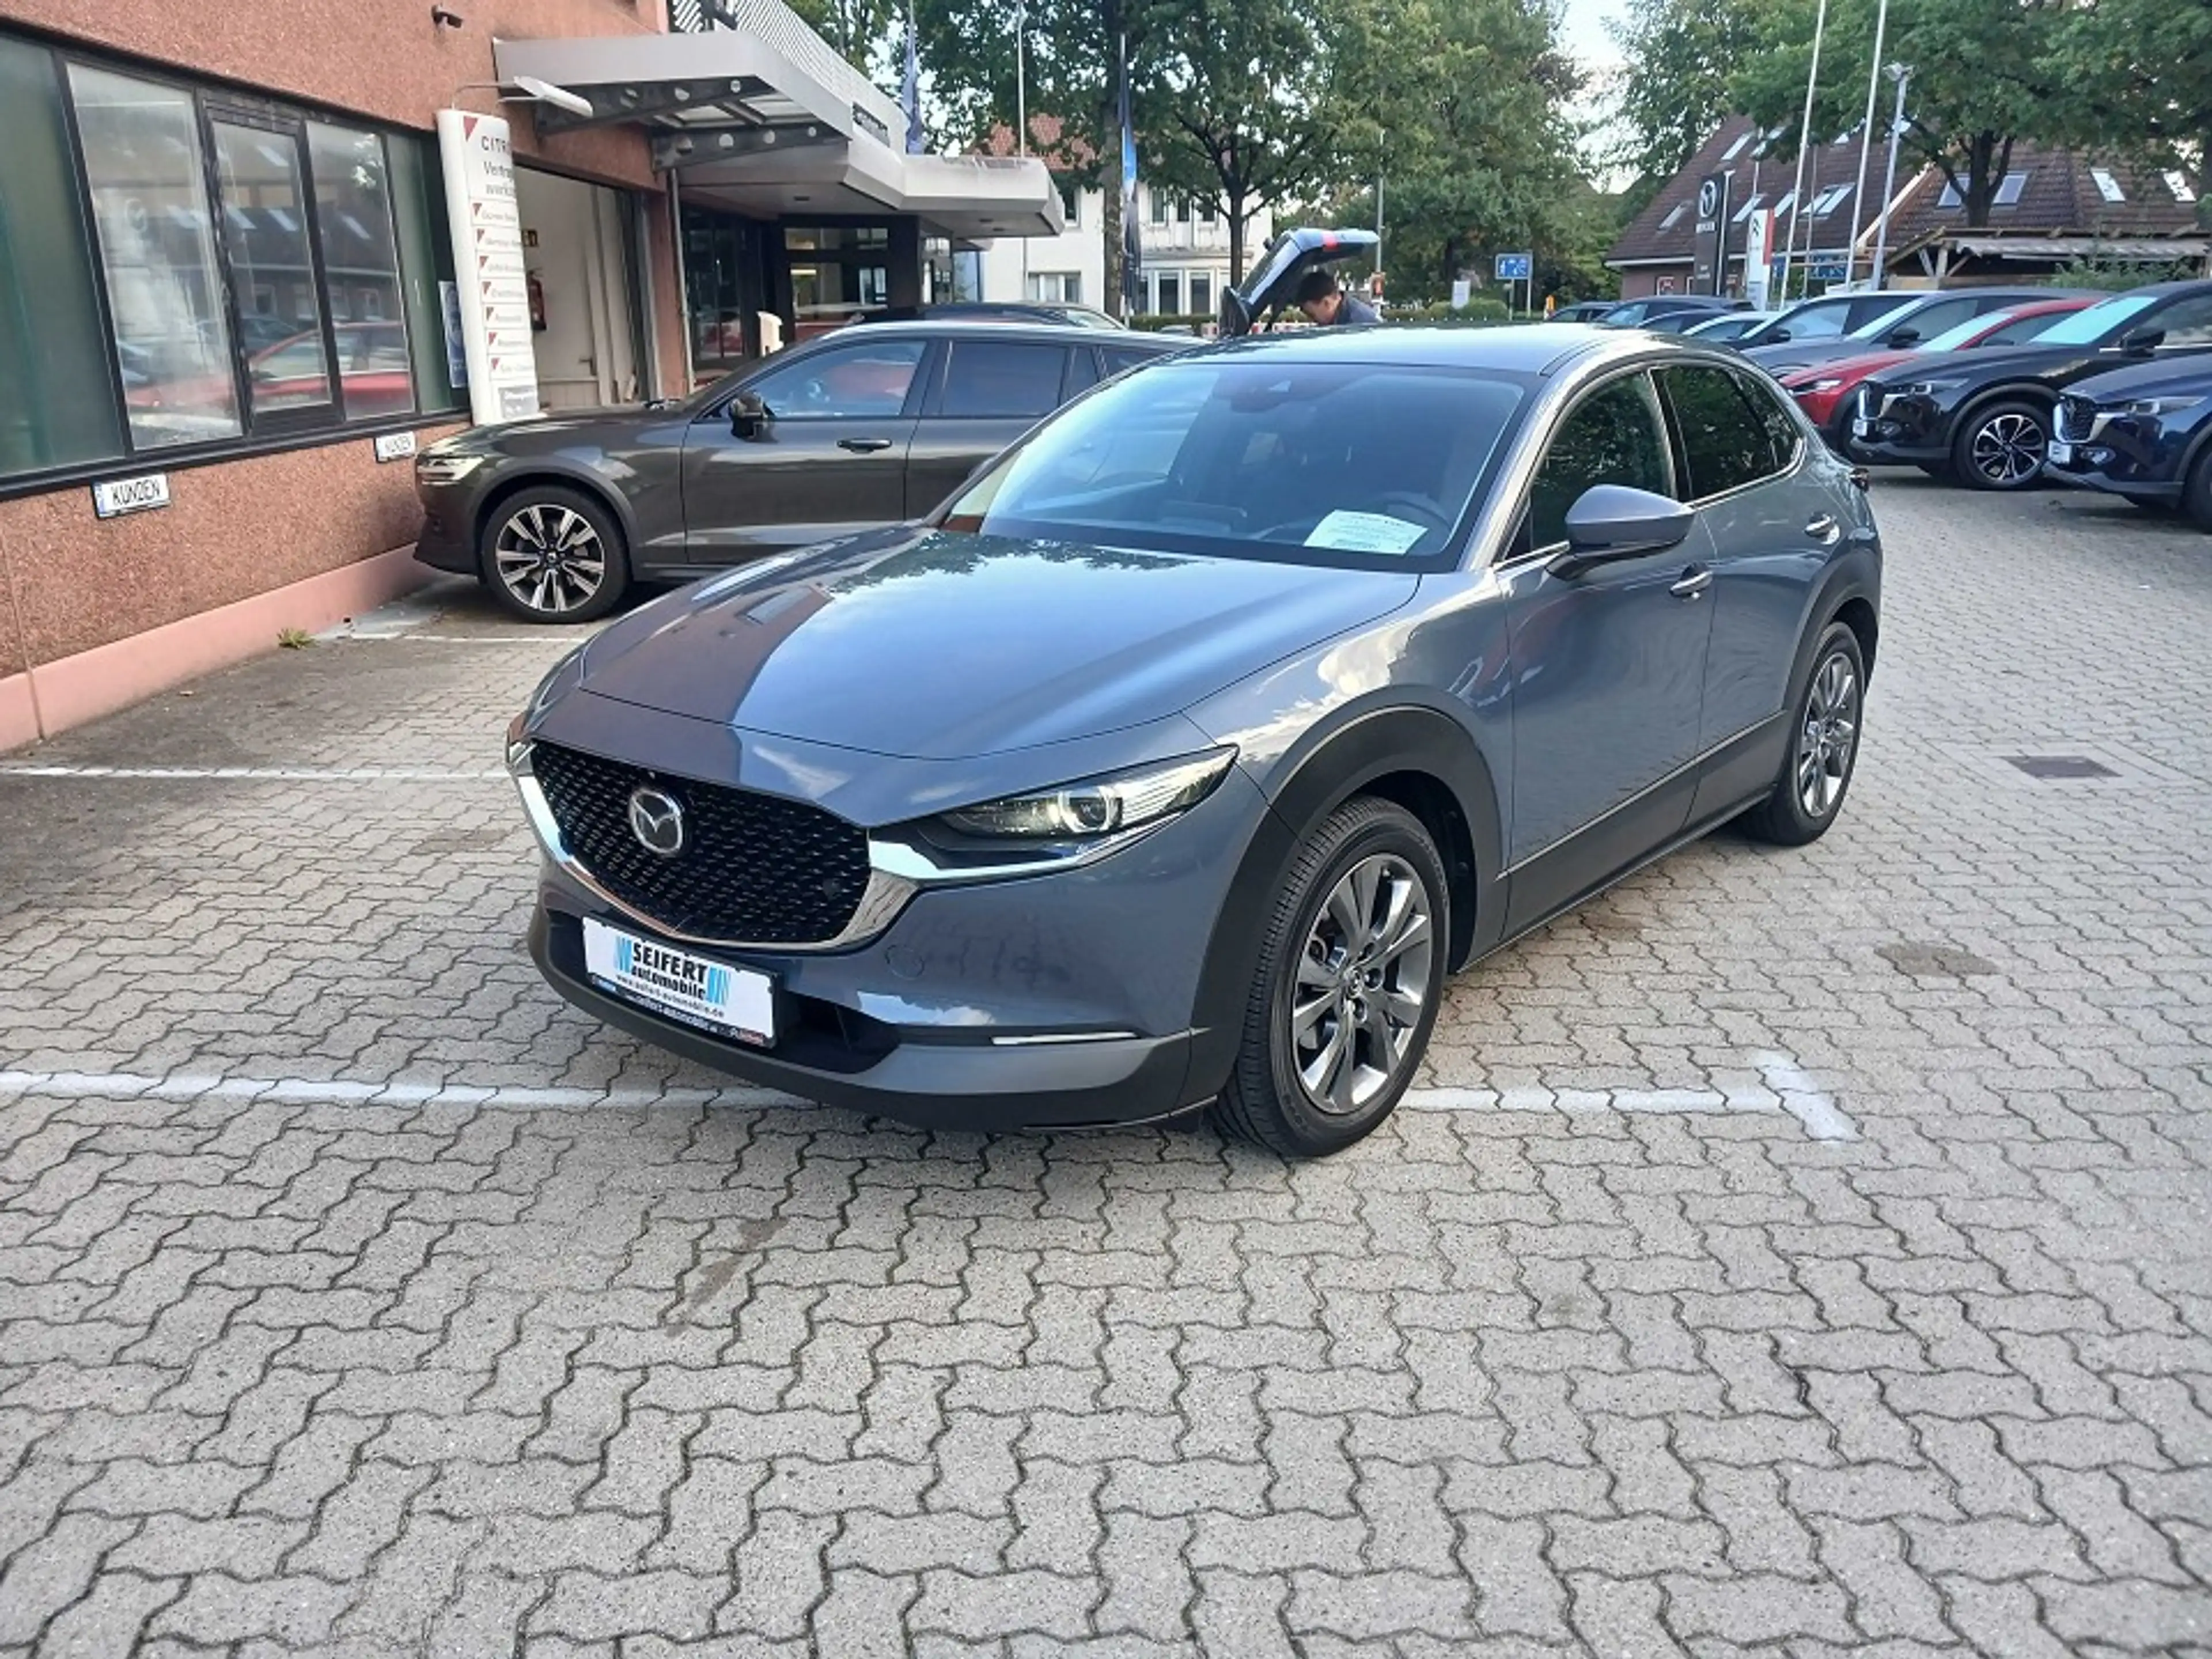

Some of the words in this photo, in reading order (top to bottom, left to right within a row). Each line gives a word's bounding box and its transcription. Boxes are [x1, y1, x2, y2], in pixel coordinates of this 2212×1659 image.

[111, 478, 160, 506] KUNDEN
[633, 941, 708, 984] SEIFERT
[631, 965, 706, 1001] automobile
